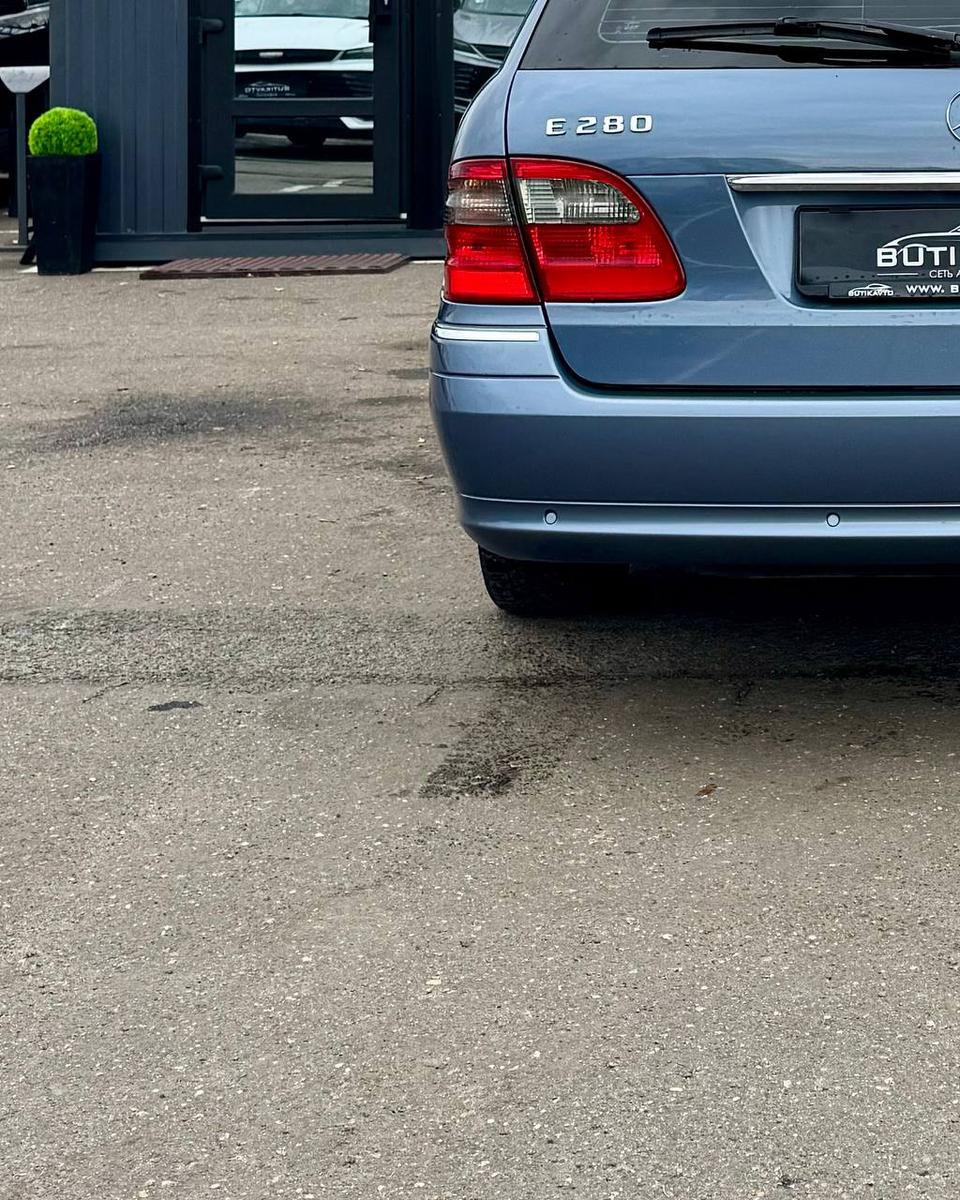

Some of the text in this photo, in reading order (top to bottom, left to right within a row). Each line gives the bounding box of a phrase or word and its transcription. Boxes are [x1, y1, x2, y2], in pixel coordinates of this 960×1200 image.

[545, 115, 653, 136] E 280
[929, 269, 953, 279] СЕТЬ
